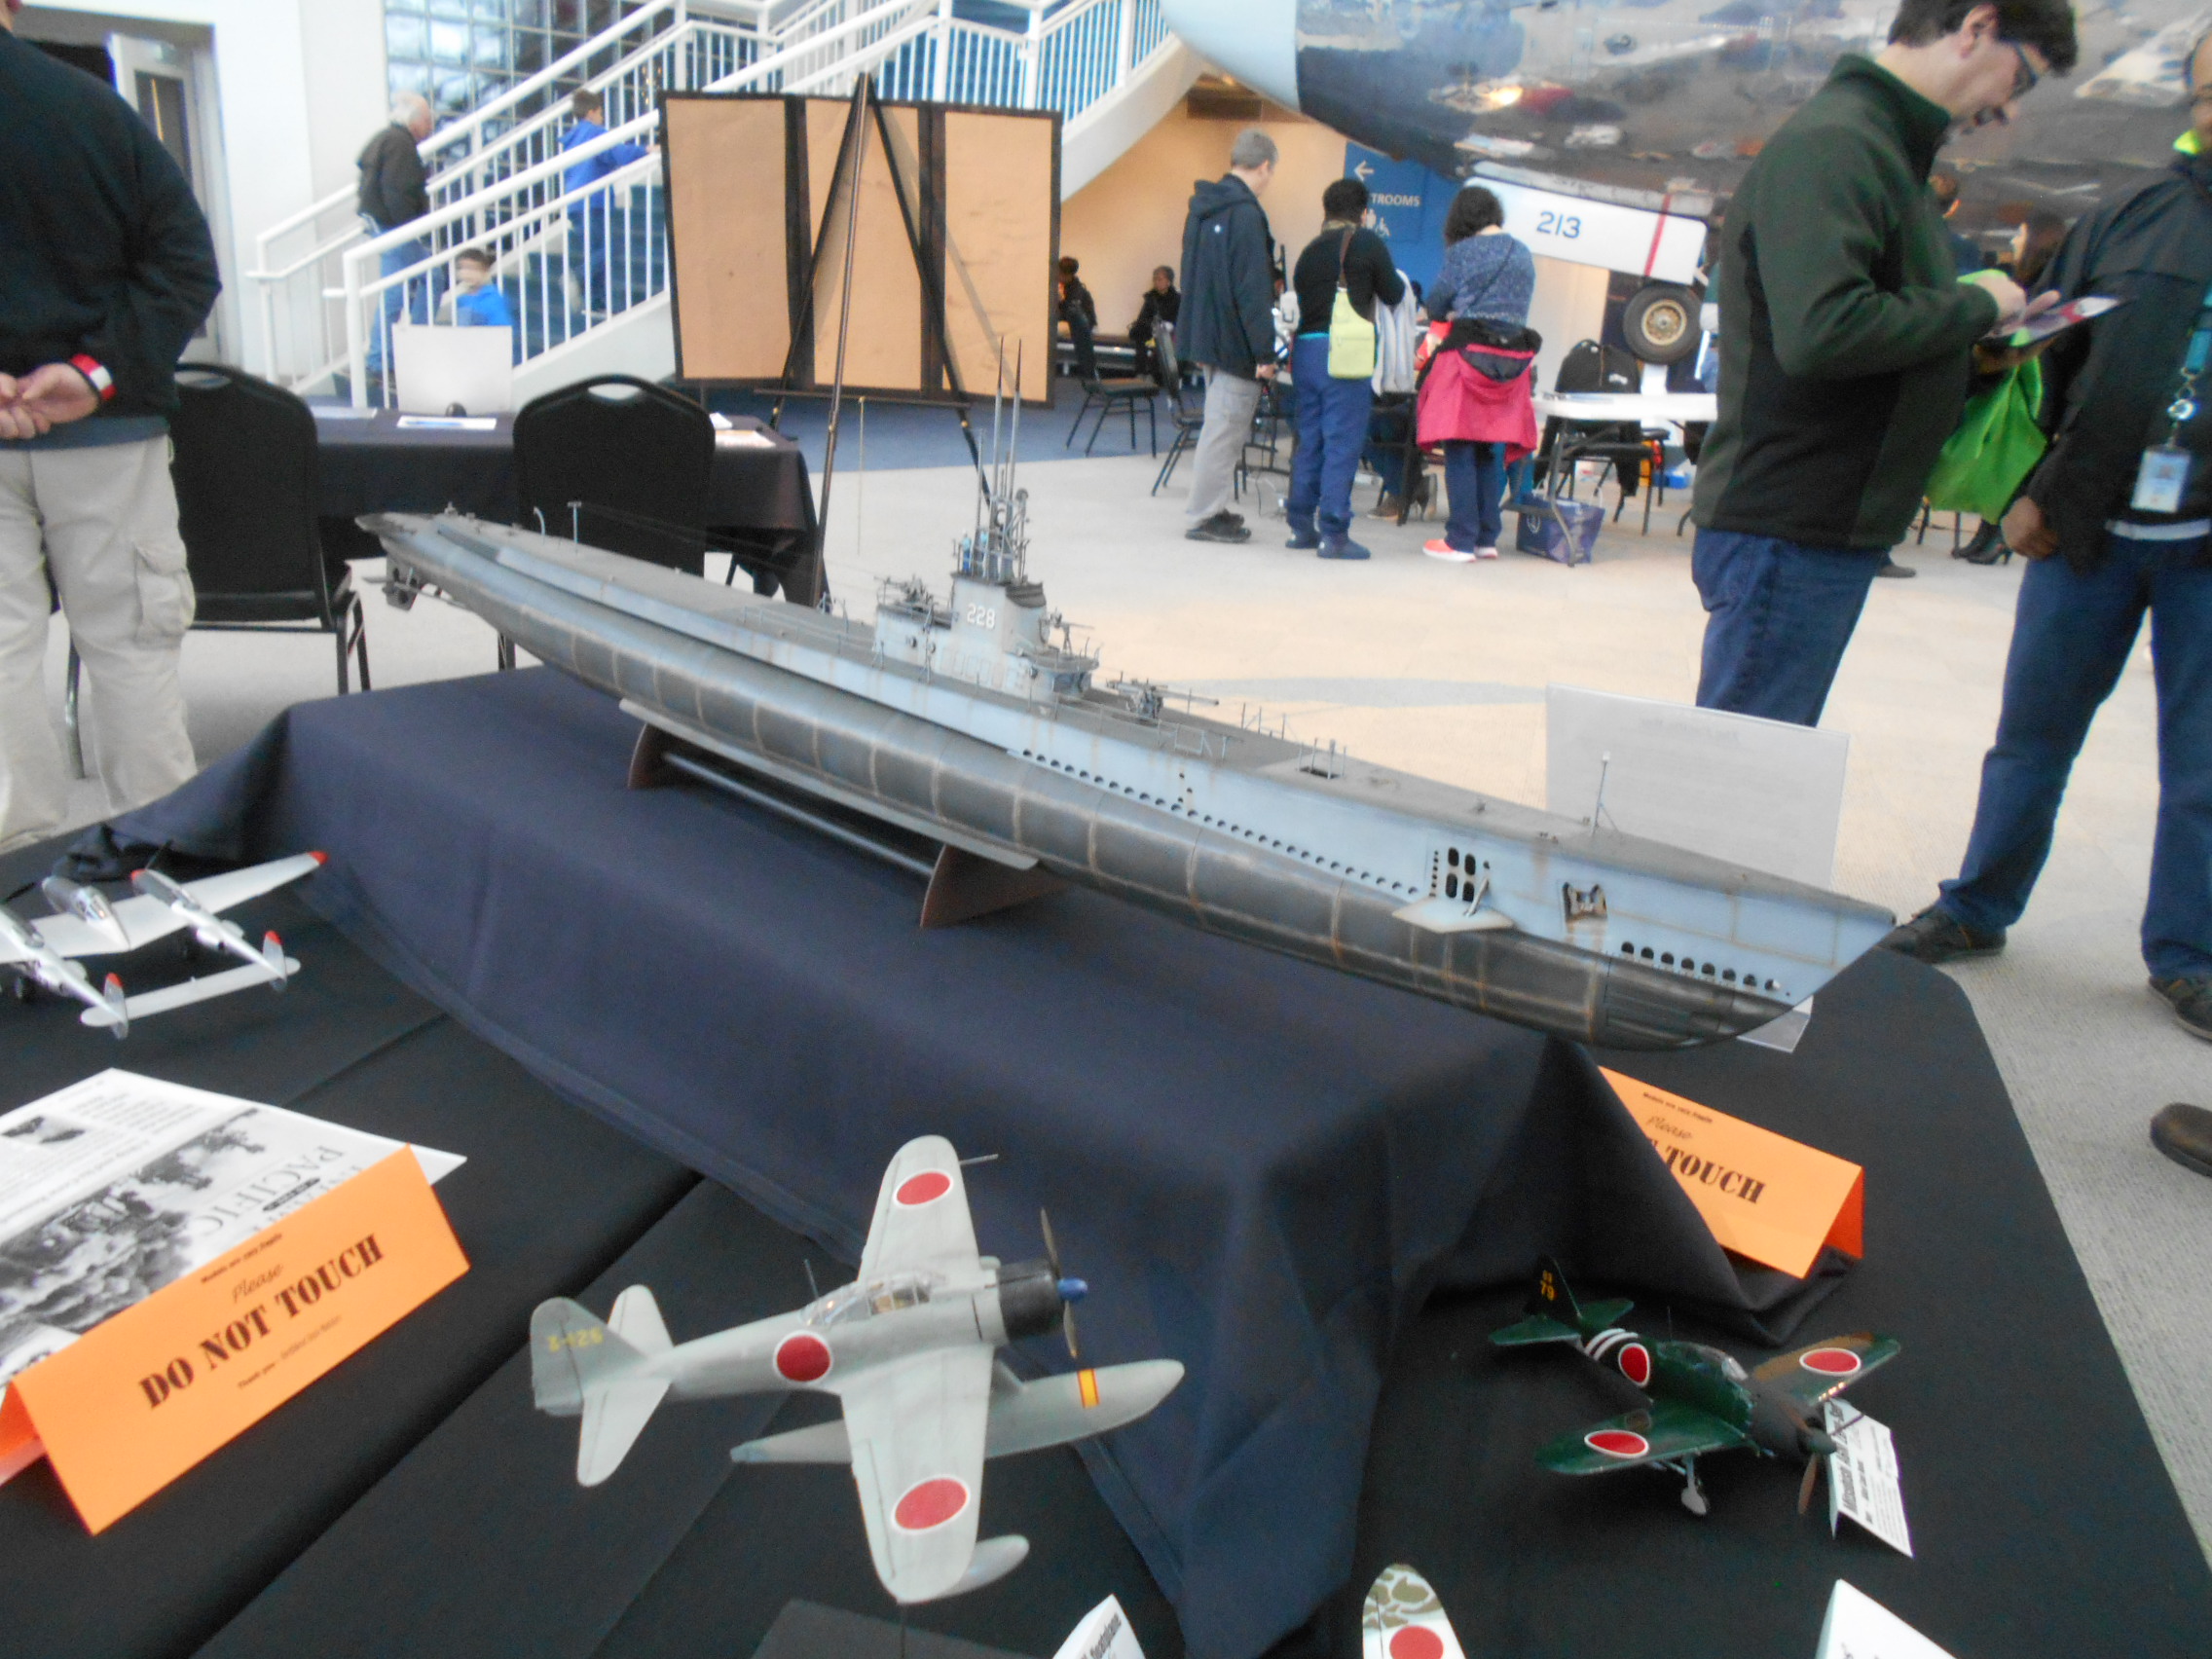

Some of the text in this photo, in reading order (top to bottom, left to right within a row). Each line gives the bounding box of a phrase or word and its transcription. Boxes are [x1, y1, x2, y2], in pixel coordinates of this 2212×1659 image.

[1371, 192, 1421, 208] TROOMS
[1536, 210, 1582, 239] 213
[967, 602, 995, 630] 228
[1645, 1116, 1692, 1139] Please
[194, 1145, 345, 1236] PACIFIC
[1665, 1145, 1766, 1204] TOUCH
[232, 1264, 283, 1304] Please
[139, 1357, 195, 1409] DO
[199, 1305, 271, 1371] NOT
[275, 1233, 384, 1318] TOUCH
